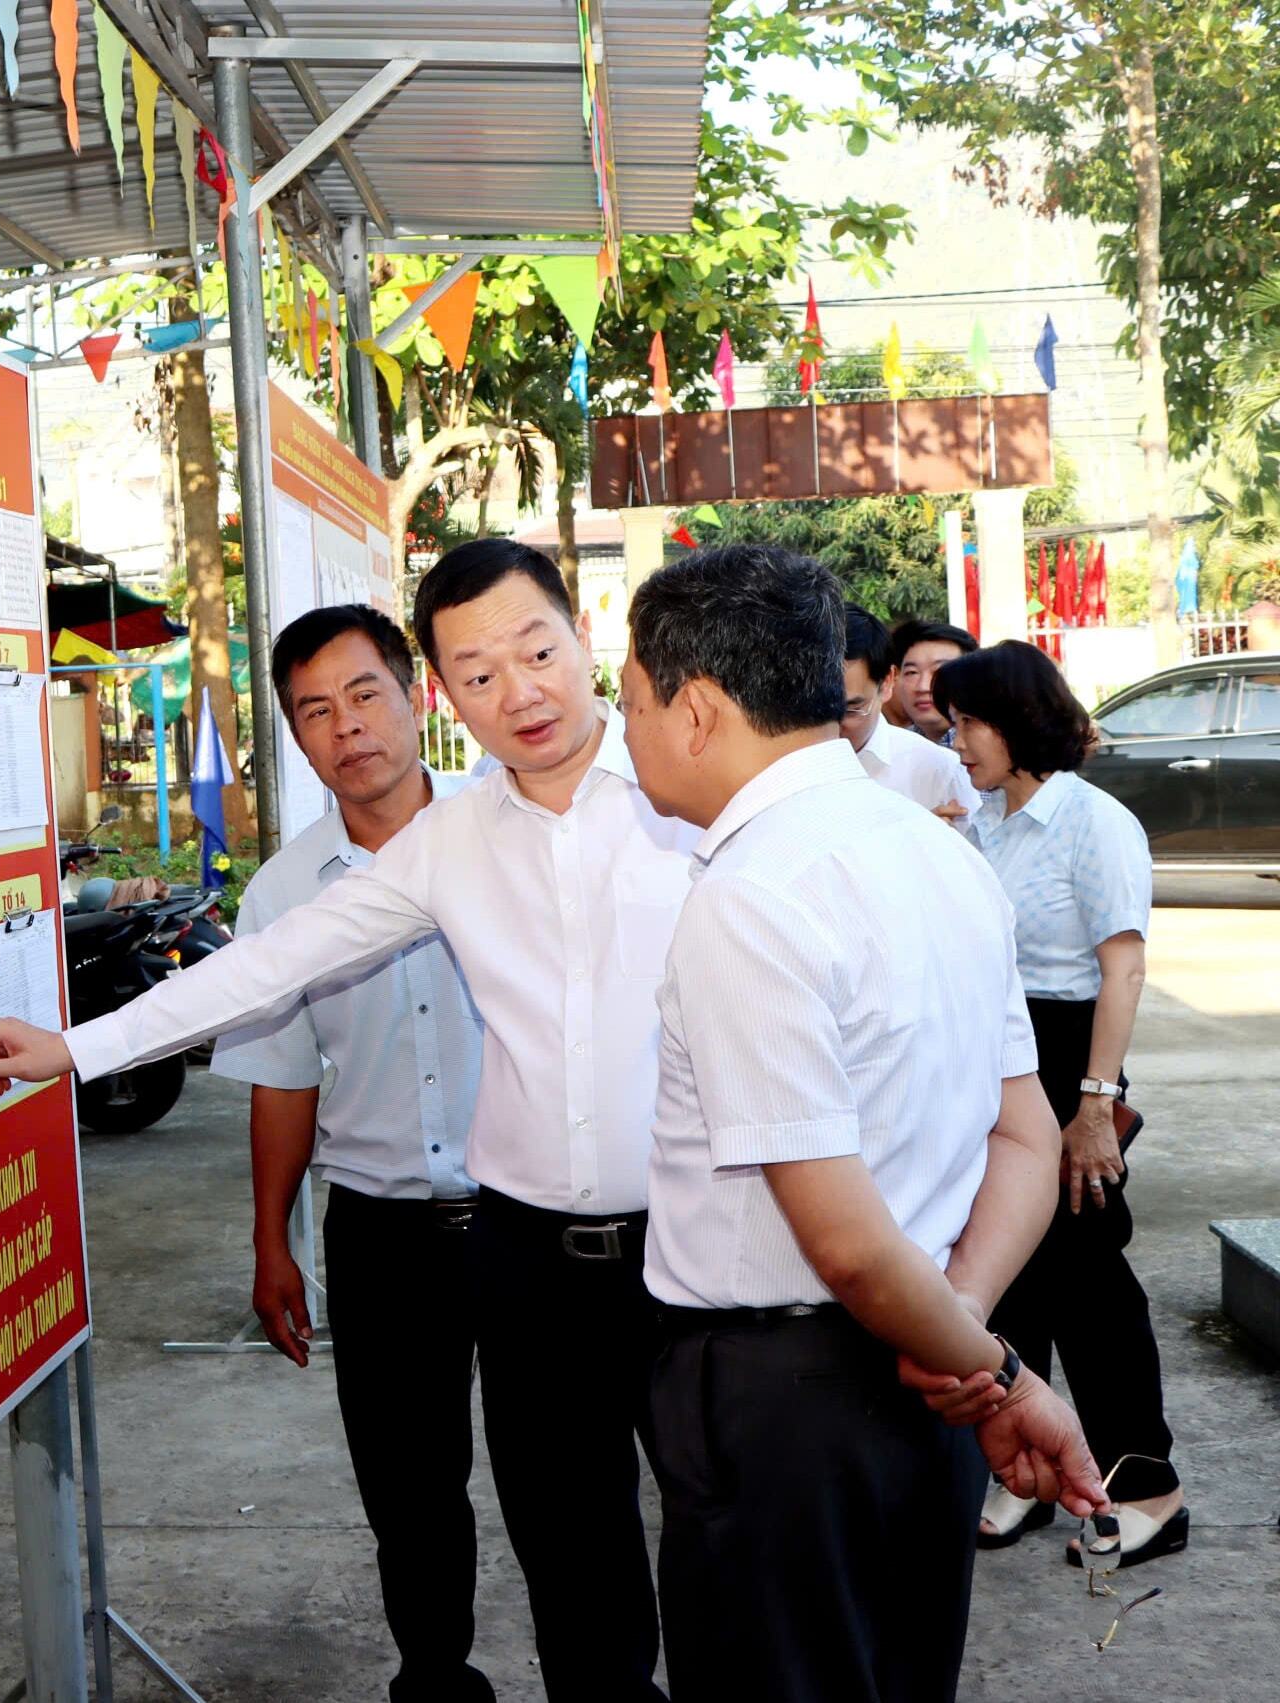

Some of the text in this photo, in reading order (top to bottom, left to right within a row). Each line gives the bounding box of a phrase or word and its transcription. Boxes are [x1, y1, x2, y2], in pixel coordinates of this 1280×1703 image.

[4, 648, 10, 664] 7
[15, 891, 26, 908] 14
[20, 1149, 38, 1195] XVI
[15, 1222, 35, 1277] CÁC
[35, 1202, 53, 1263] CẤP
[15, 1296, 35, 1356] CỦA
[34, 1283, 57, 1339] TOÀN
[56, 1269, 75, 1319] DÂN
